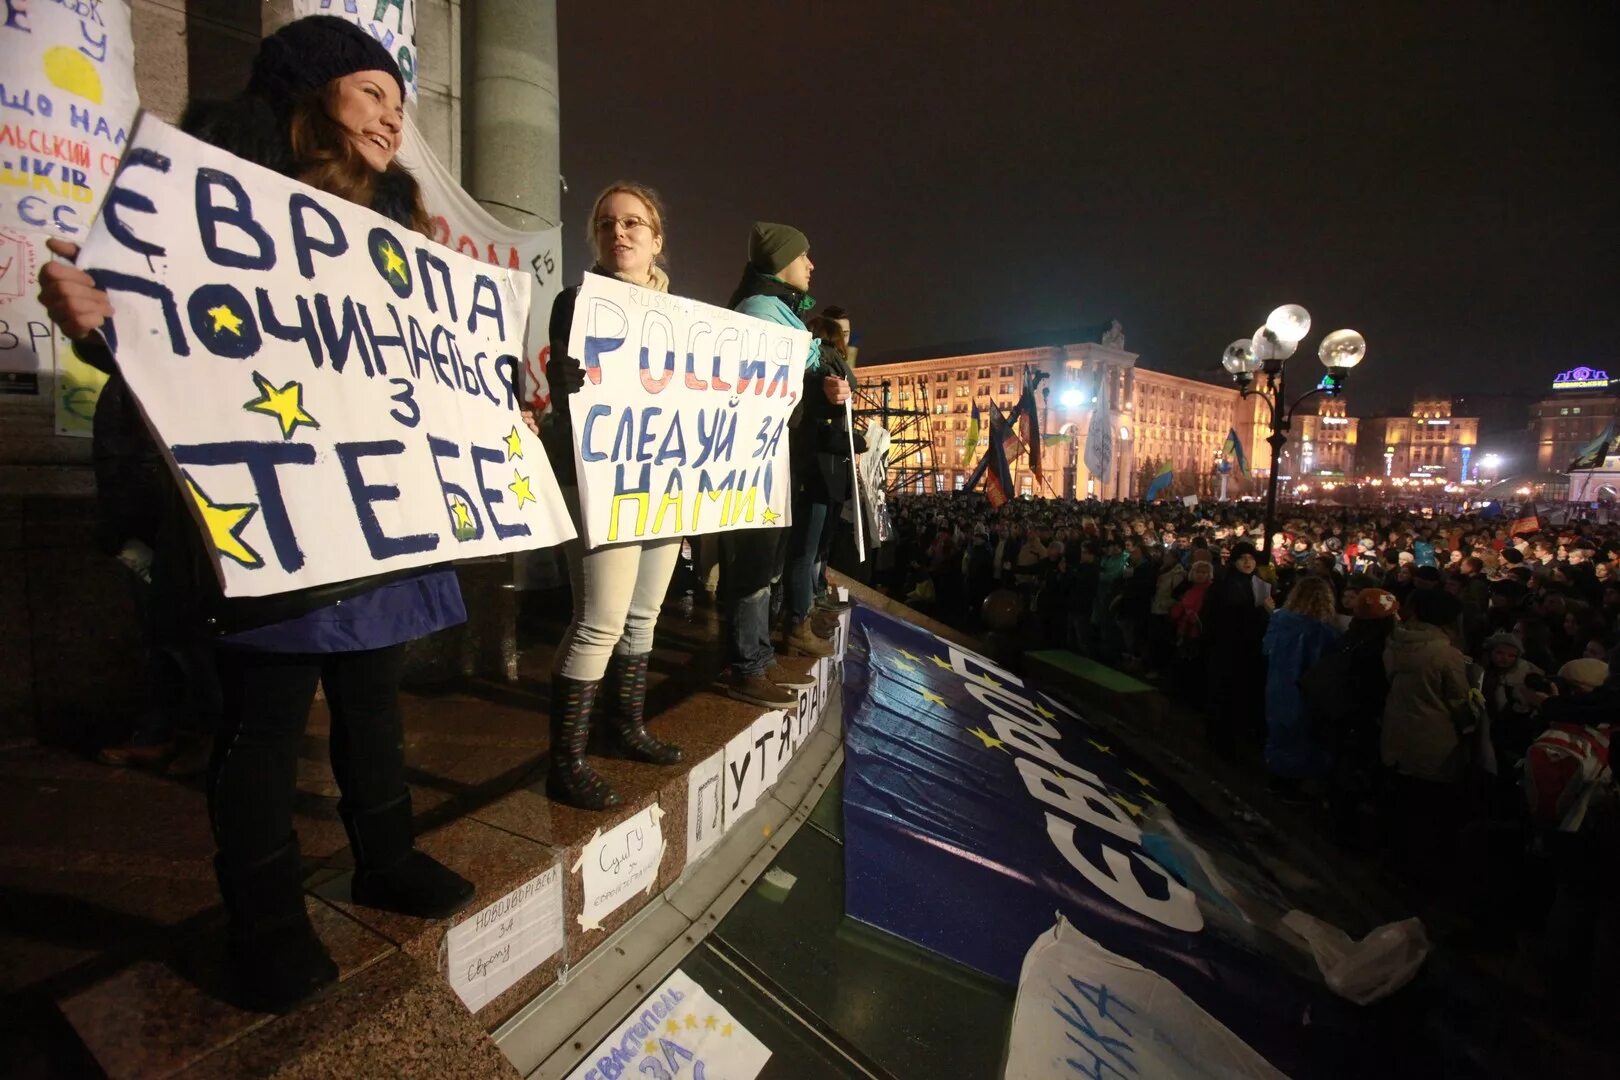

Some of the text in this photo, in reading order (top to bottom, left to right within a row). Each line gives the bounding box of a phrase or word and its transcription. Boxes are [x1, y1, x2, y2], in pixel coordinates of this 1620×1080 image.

[102, 147, 506, 342] ЄВРОПА
[83, 268, 519, 411] ПОЧИНАЄТЬСЯ
[584, 296, 797, 406] РОССИЯ,
[169, 432, 531, 574] ТЕБЕ
[581, 395, 784, 469] СЛЕДУЙ ЗА
[607, 459, 781, 541] НАМИ!
[932, 633, 1204, 933] ЄВРОП
